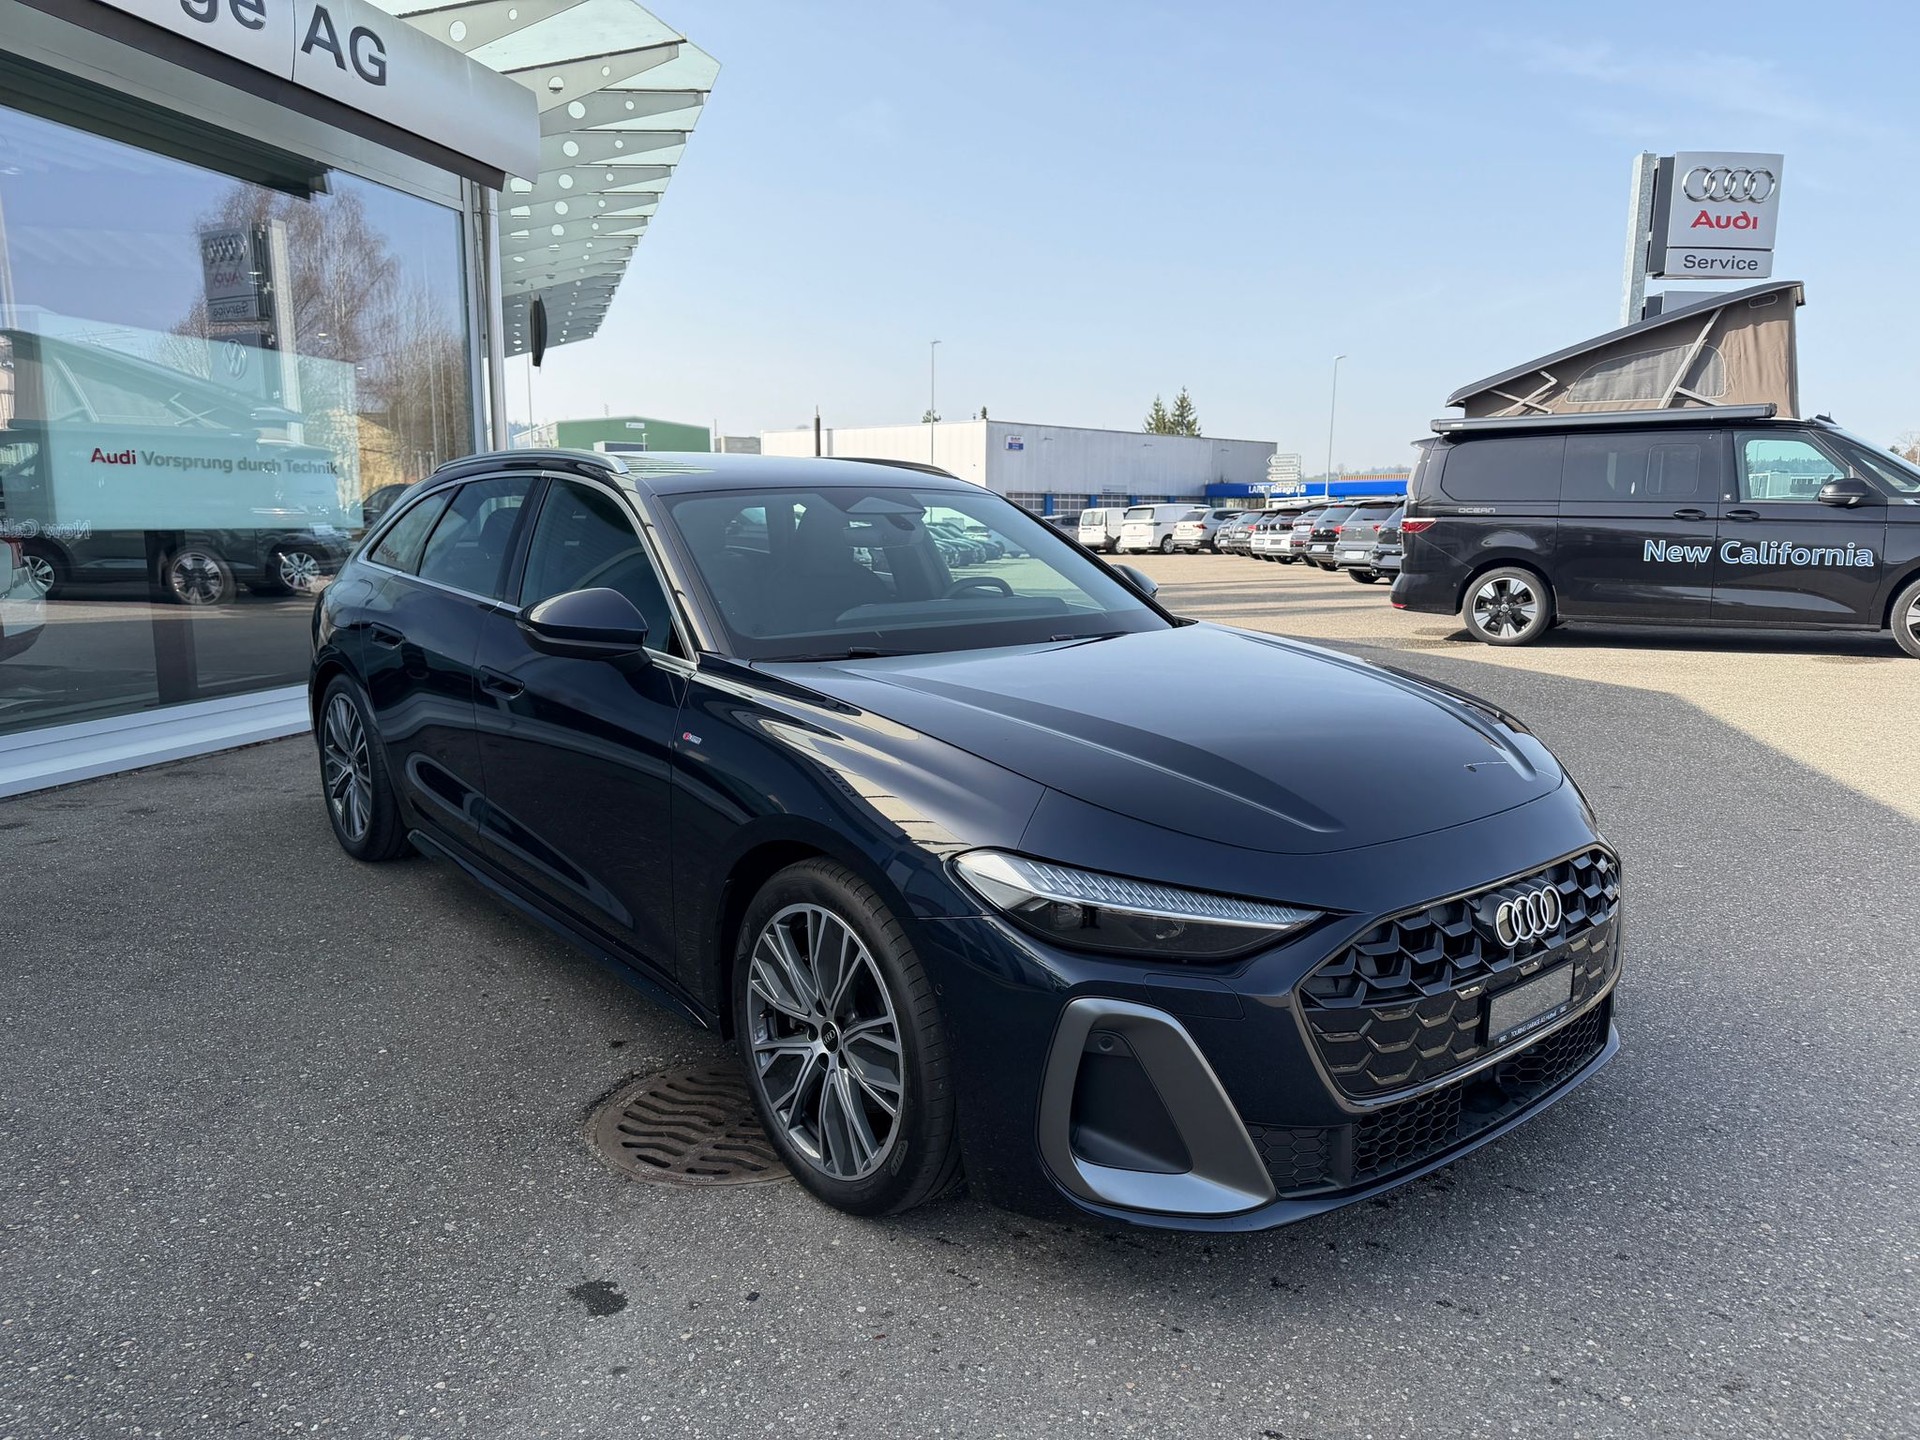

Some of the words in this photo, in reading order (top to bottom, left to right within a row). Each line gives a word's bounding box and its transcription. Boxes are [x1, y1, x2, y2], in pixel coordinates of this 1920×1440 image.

[300, 4, 387, 87] AG
[1690, 210, 1758, 230] Audi
[1683, 254, 1758, 271] Service
[90, 448, 137, 465] Audi
[140, 450, 233, 474] Vorsprung
[237, 456, 281, 474] durch
[284, 458, 338, 475] Technik
[1643, 539, 1712, 563] New
[1720, 540, 1874, 567] California
